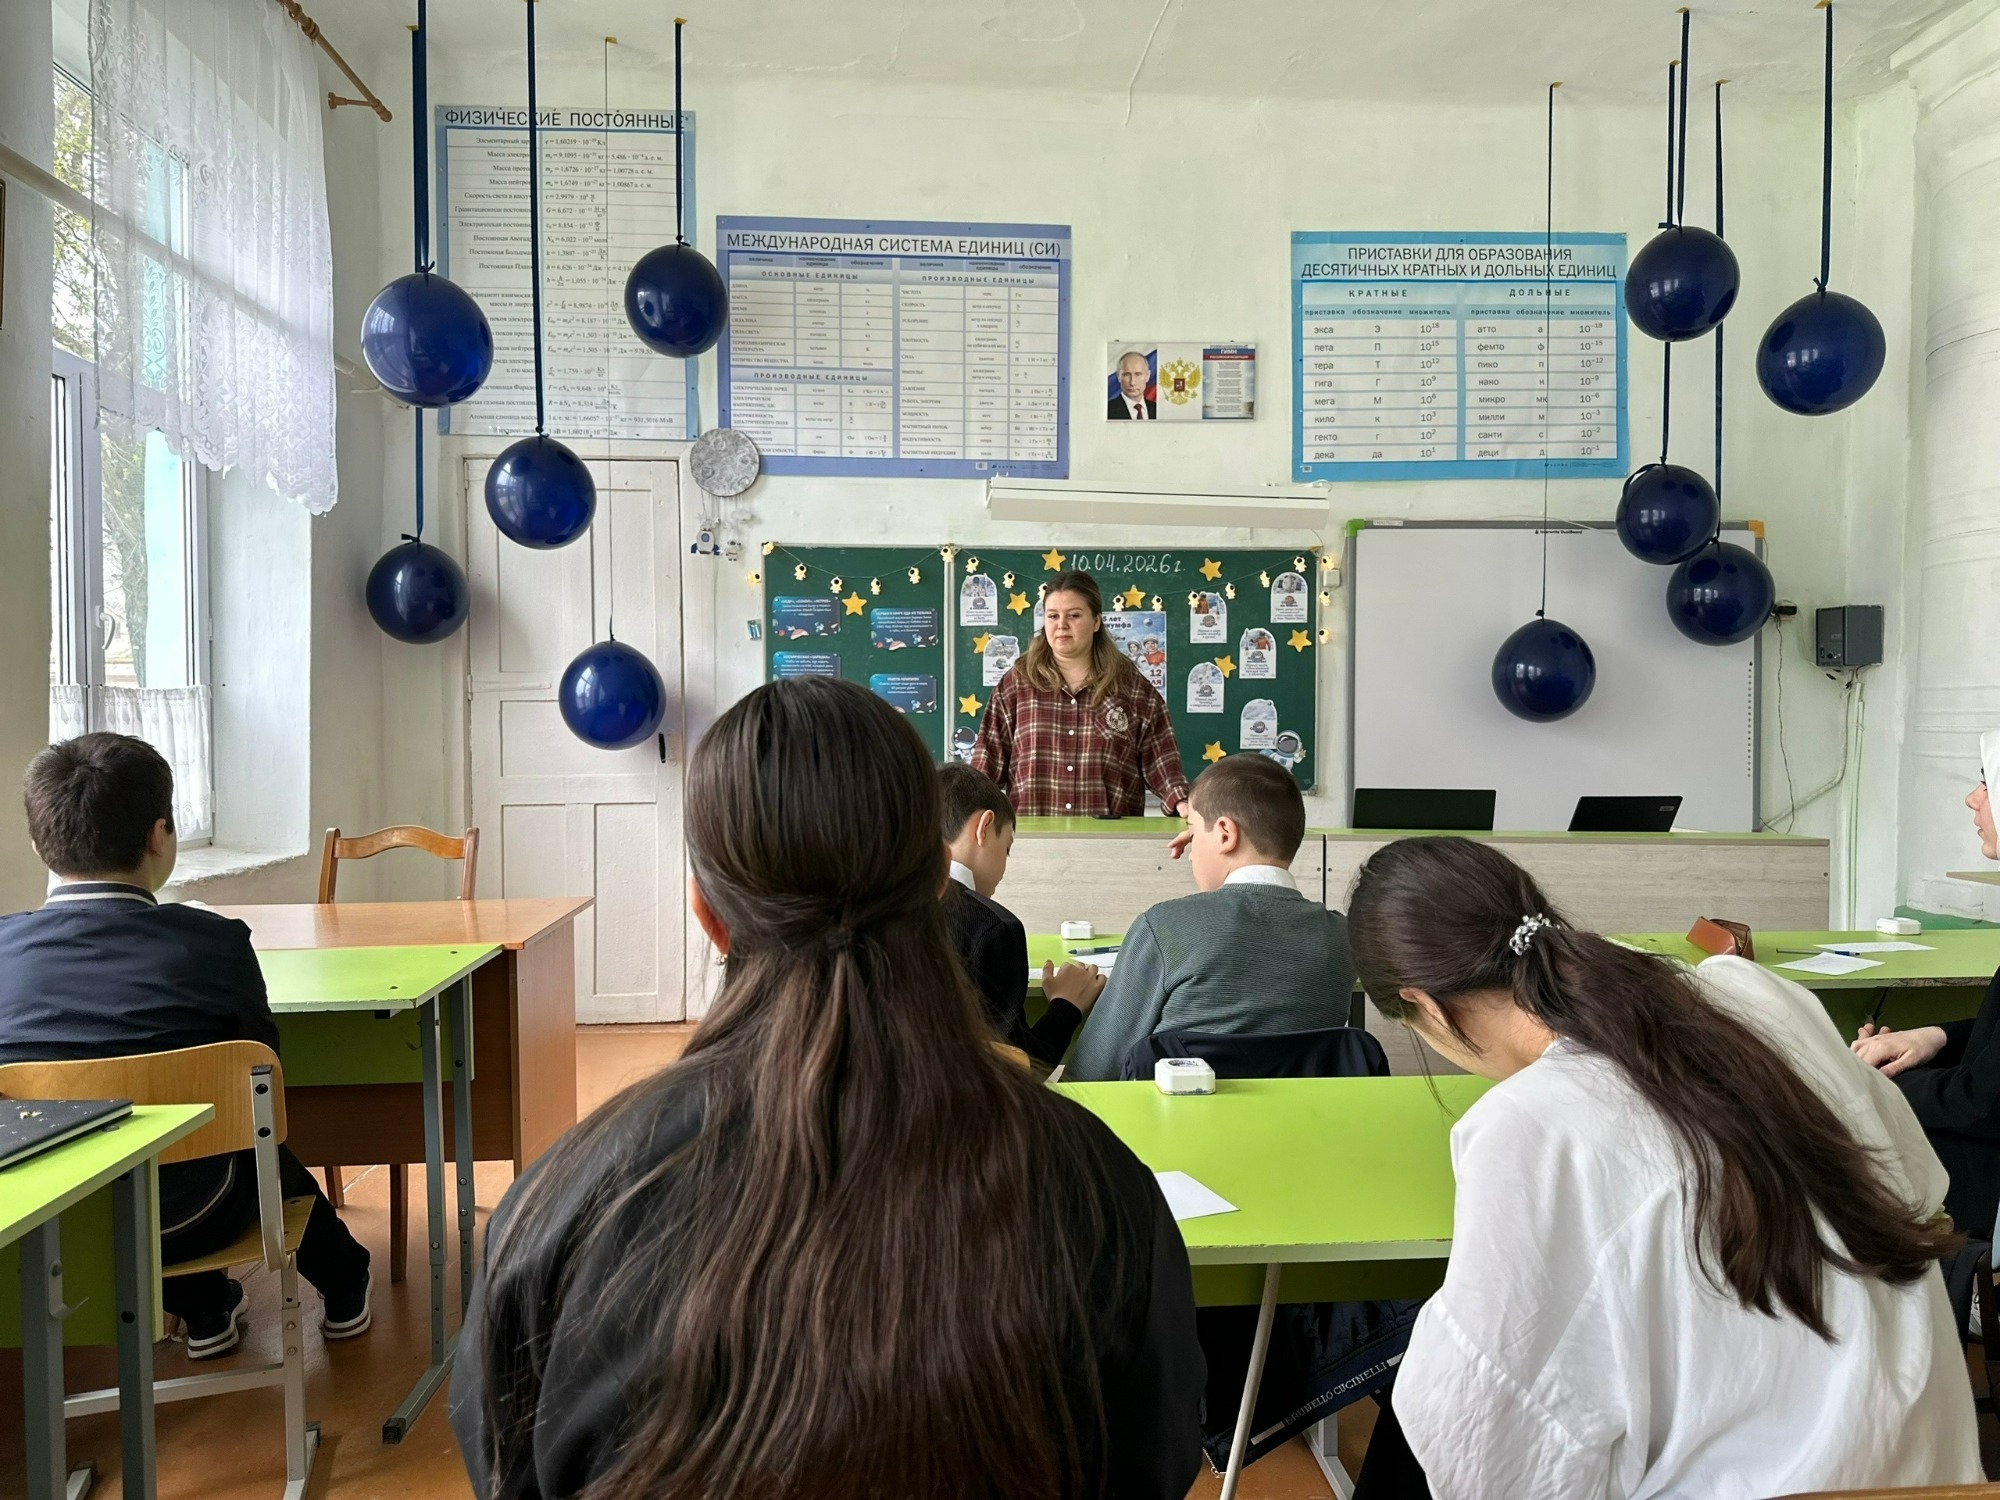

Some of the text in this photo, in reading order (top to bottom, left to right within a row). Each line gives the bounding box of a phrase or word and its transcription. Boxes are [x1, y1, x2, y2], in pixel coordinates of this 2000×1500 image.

[445, 109, 561, 126] ФИЗИЧЕСИЕ
[727, 233, 1061, 257] МЕЖДУНАРОДНАЯ СИСТЕМА ЕДИНИЦ (СИ)
[1348, 248, 1572, 262] ПРИСТАВКИ ДЛЯ ОБРАЗОВАНИЯ
[761, 271, 858, 280] ОСНОВНЫЕ ЕДИНИЦЫ
[1301, 264, 1616, 279] ДЕСЯТИЧНЫХ КРАТНЫХ И ДОЛЬНЫХ ЕДИНИЦ
[1349, 289, 1407, 297] КРАТНЫЕ
[1509, 289, 1571, 297] ДОЛЬНЫЕ
[1314, 326, 1334, 334] экса
[1314, 344, 1334, 352] пета
[1477, 343, 1505, 351] фемто
[1314, 362, 1334, 370] тера
[1478, 396, 1506, 404] микро
[1314, 451, 1335, 459] дека
[1478, 449, 1499, 457] деци
[1150, 669, 1161, 677] 12
[1284, 1361, 1387, 1426] BRUNELLO CUCINELLI
